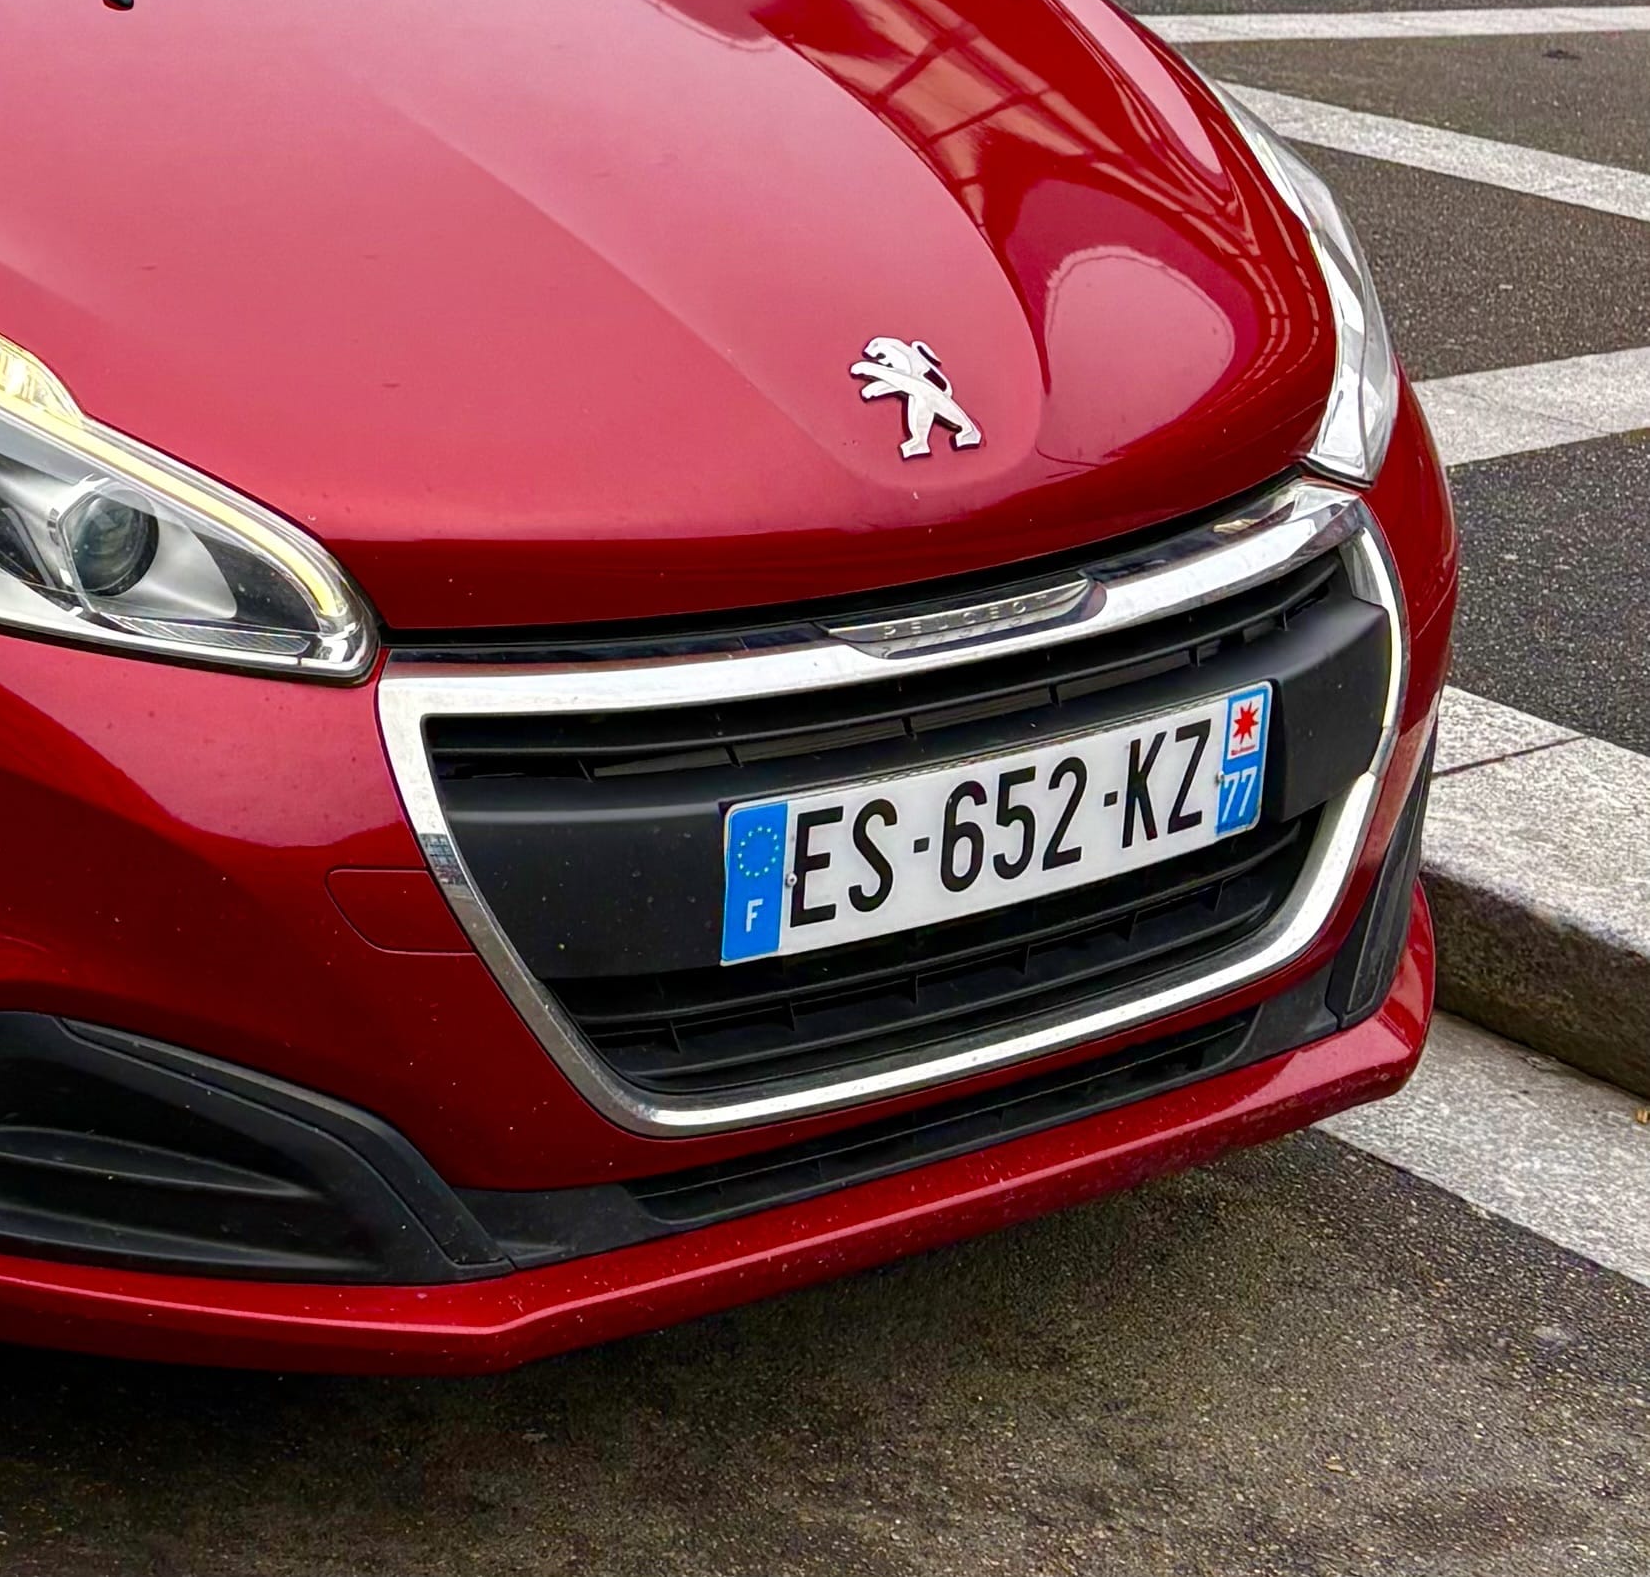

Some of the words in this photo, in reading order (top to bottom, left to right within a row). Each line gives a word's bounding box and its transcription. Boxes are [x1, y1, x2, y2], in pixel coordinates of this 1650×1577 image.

[883, 594, 1048, 640] PEUGEOT
[1221, 765, 1258, 823] 77
[789, 718, 1212, 928] ES-652-KZ
[745, 898, 763, 932] F
